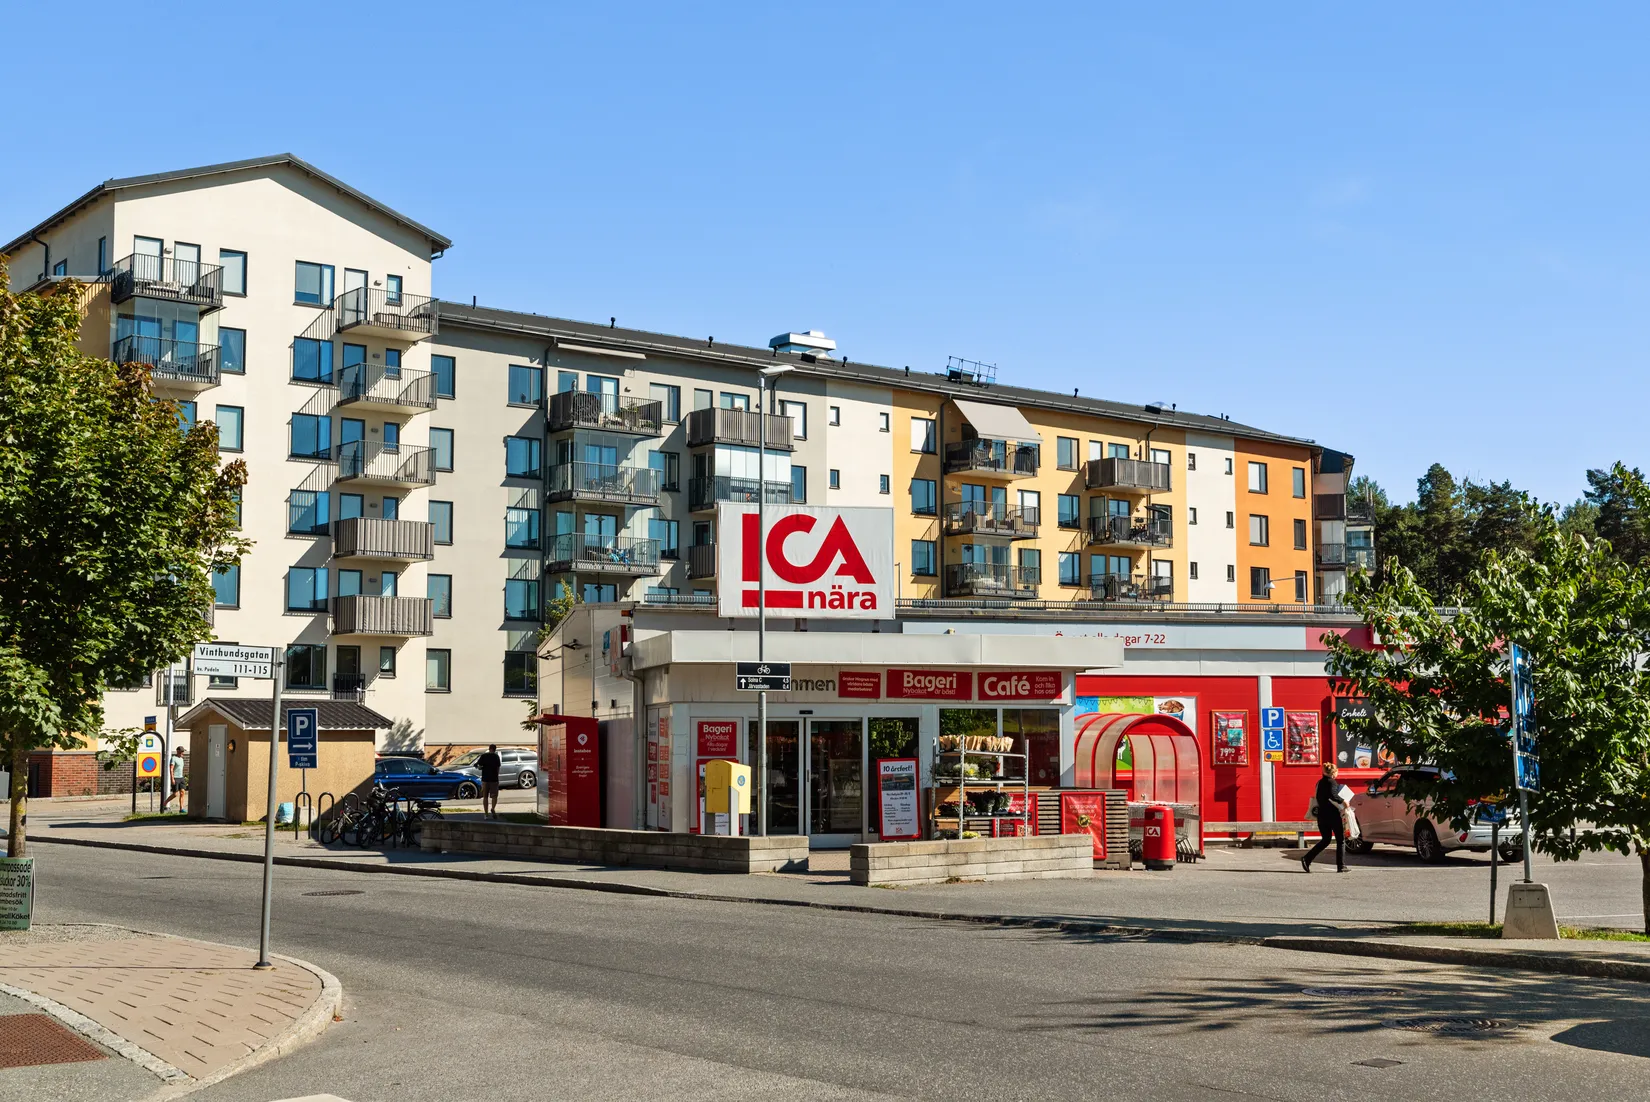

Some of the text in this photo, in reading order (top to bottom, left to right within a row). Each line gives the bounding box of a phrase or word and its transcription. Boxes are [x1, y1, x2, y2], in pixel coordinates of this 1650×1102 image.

[742, 513, 876, 584] ICA
[808, 585, 877, 609] nära
[1144, 634, 1166, 644] 7-22
[199, 646, 269, 660] Vinthundsgatan
[233, 664, 268, 675] 111-115
[903, 672, 957, 692] Bageri
[983, 675, 1031, 697] Café
[903, 687, 927, 695] Nybakat
[1268, 709, 1280, 727] P
[295, 716, 309, 736] P
[703, 724, 732, 735] Bageri
[1145, 827, 1159, 836] ICA
[17, 875, 31, 888] 30%
